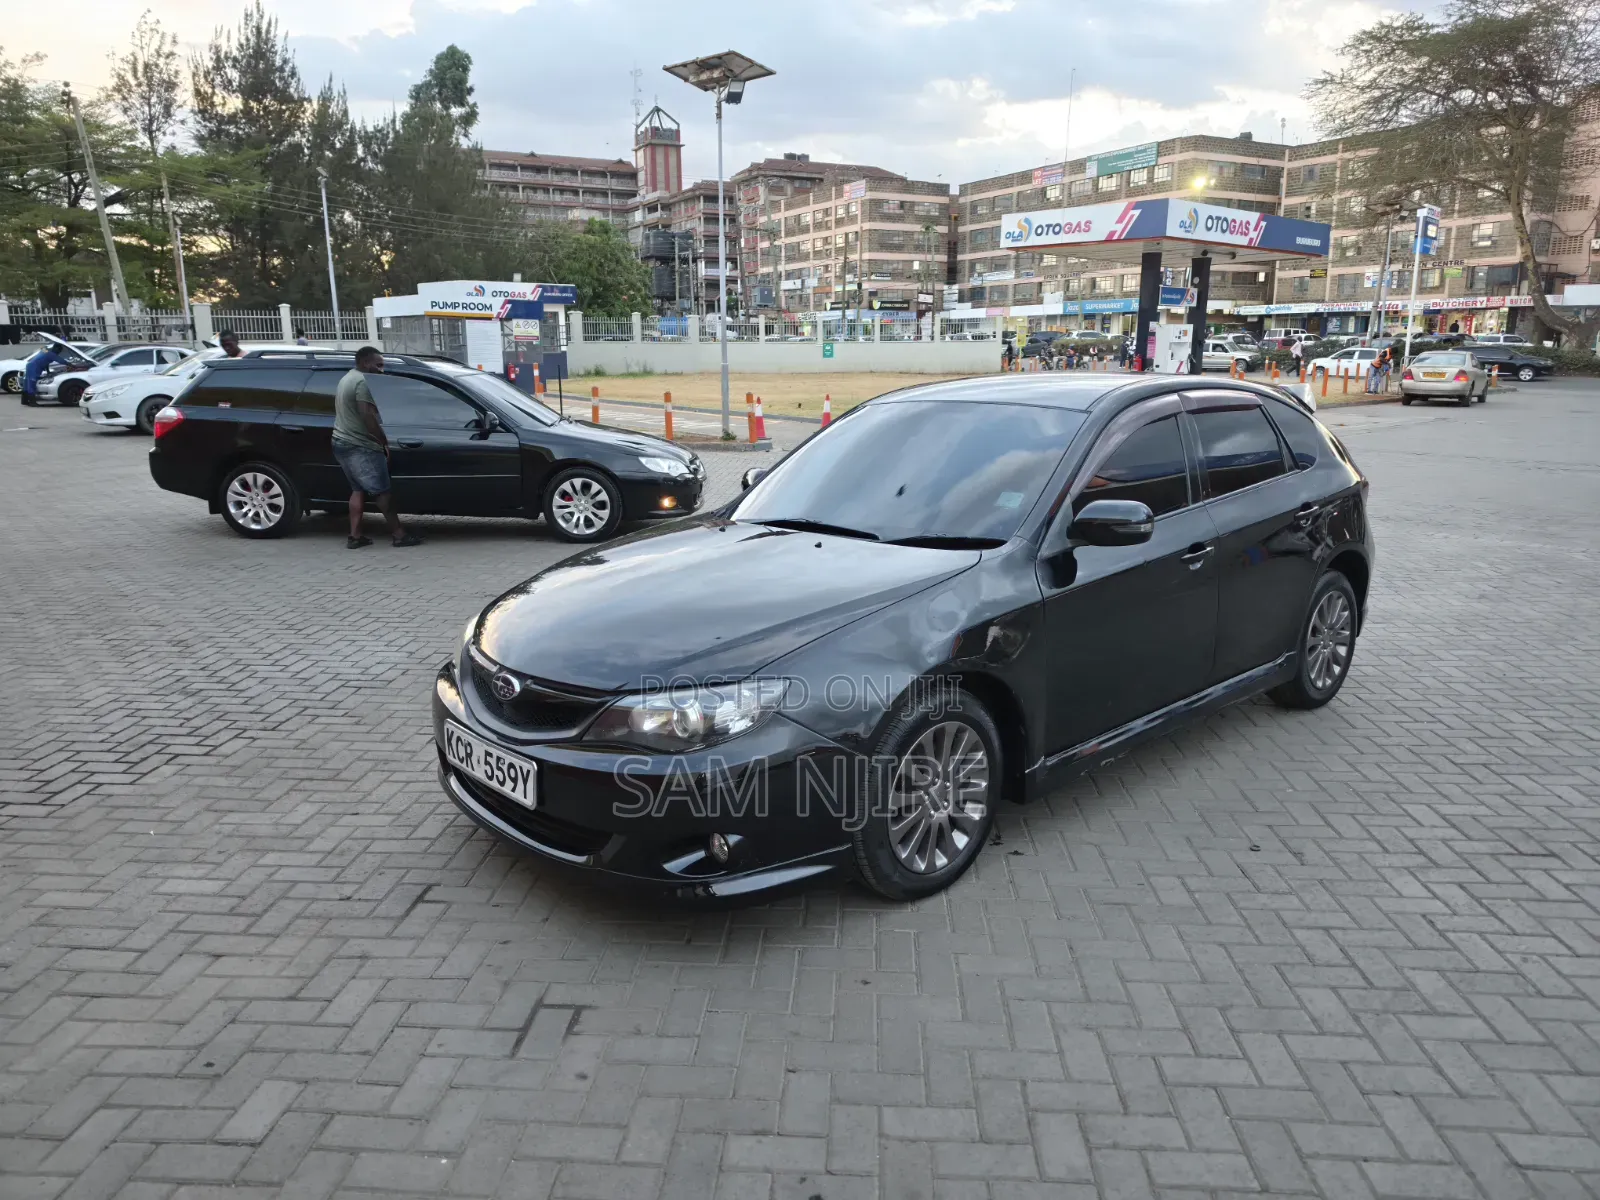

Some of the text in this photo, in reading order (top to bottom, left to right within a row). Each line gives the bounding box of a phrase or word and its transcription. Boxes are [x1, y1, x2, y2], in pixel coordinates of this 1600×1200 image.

[1034, 220, 1093, 237] OTOGAS
[1179, 219, 1193, 230] OLA
[1205, 214, 1251, 237] OTOGAS
[1005, 231, 1023, 240] OLA
[1432, 259, 1465, 267] CENTRE
[491, 289, 528, 299] OTOGAS
[430, 300, 493, 312] PUMP ROOM
[1085, 302, 1125, 310] SUPERMARKET
[1431, 299, 1485, 308] BUTCHERY
[1509, 297, 1532, 305] BUTCH
[446, 727, 531, 800] KCR 559Y
